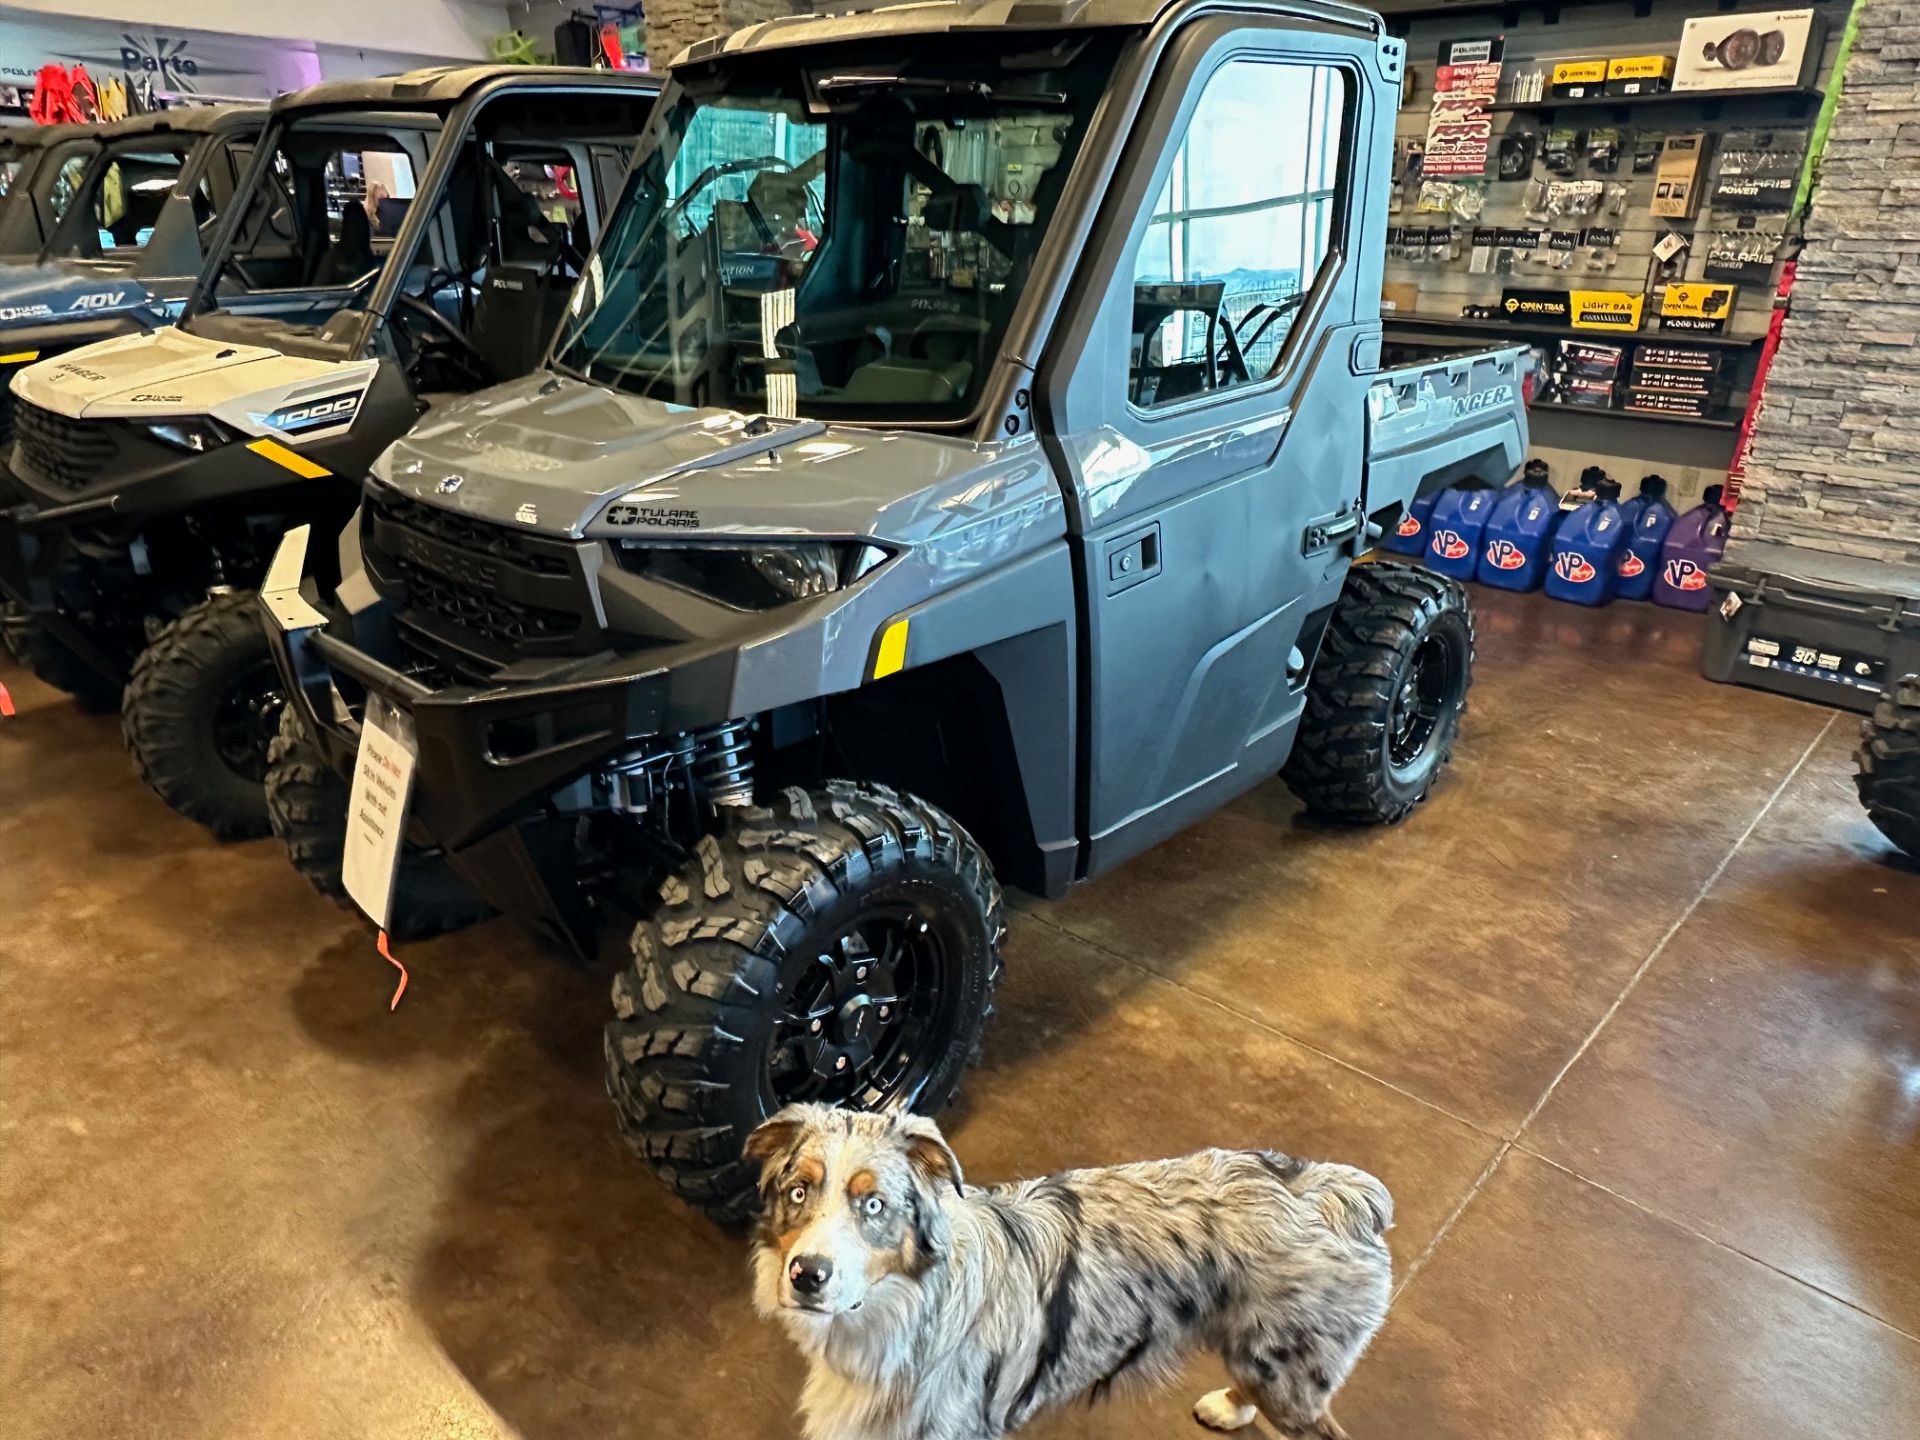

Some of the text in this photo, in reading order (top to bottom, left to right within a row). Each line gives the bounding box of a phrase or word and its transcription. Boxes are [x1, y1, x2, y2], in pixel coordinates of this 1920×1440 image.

[120, 48, 199, 76] Parts
[1718, 186, 1759, 195] POWER
[1721, 178, 1792, 189] POLARIS
[1708, 250, 1774, 264] POLARIS
[69, 291, 126, 310] ADV
[1520, 301, 1543, 310] OPEN
[1544, 302, 1566, 312] TRAIL
[1582, 301, 1633, 311] LIGHT BAR
[1666, 320, 1716, 329] FLOOD LIGHT
[276, 397, 358, 427] 1000
[640, 508, 699, 519] TULARE
[636, 517, 700, 528] POLARIS
[1435, 530, 1459, 557] VP
[1490, 541, 1515, 568] VP
[1558, 552, 1584, 580] VP
[1668, 560, 1697, 589] VP
